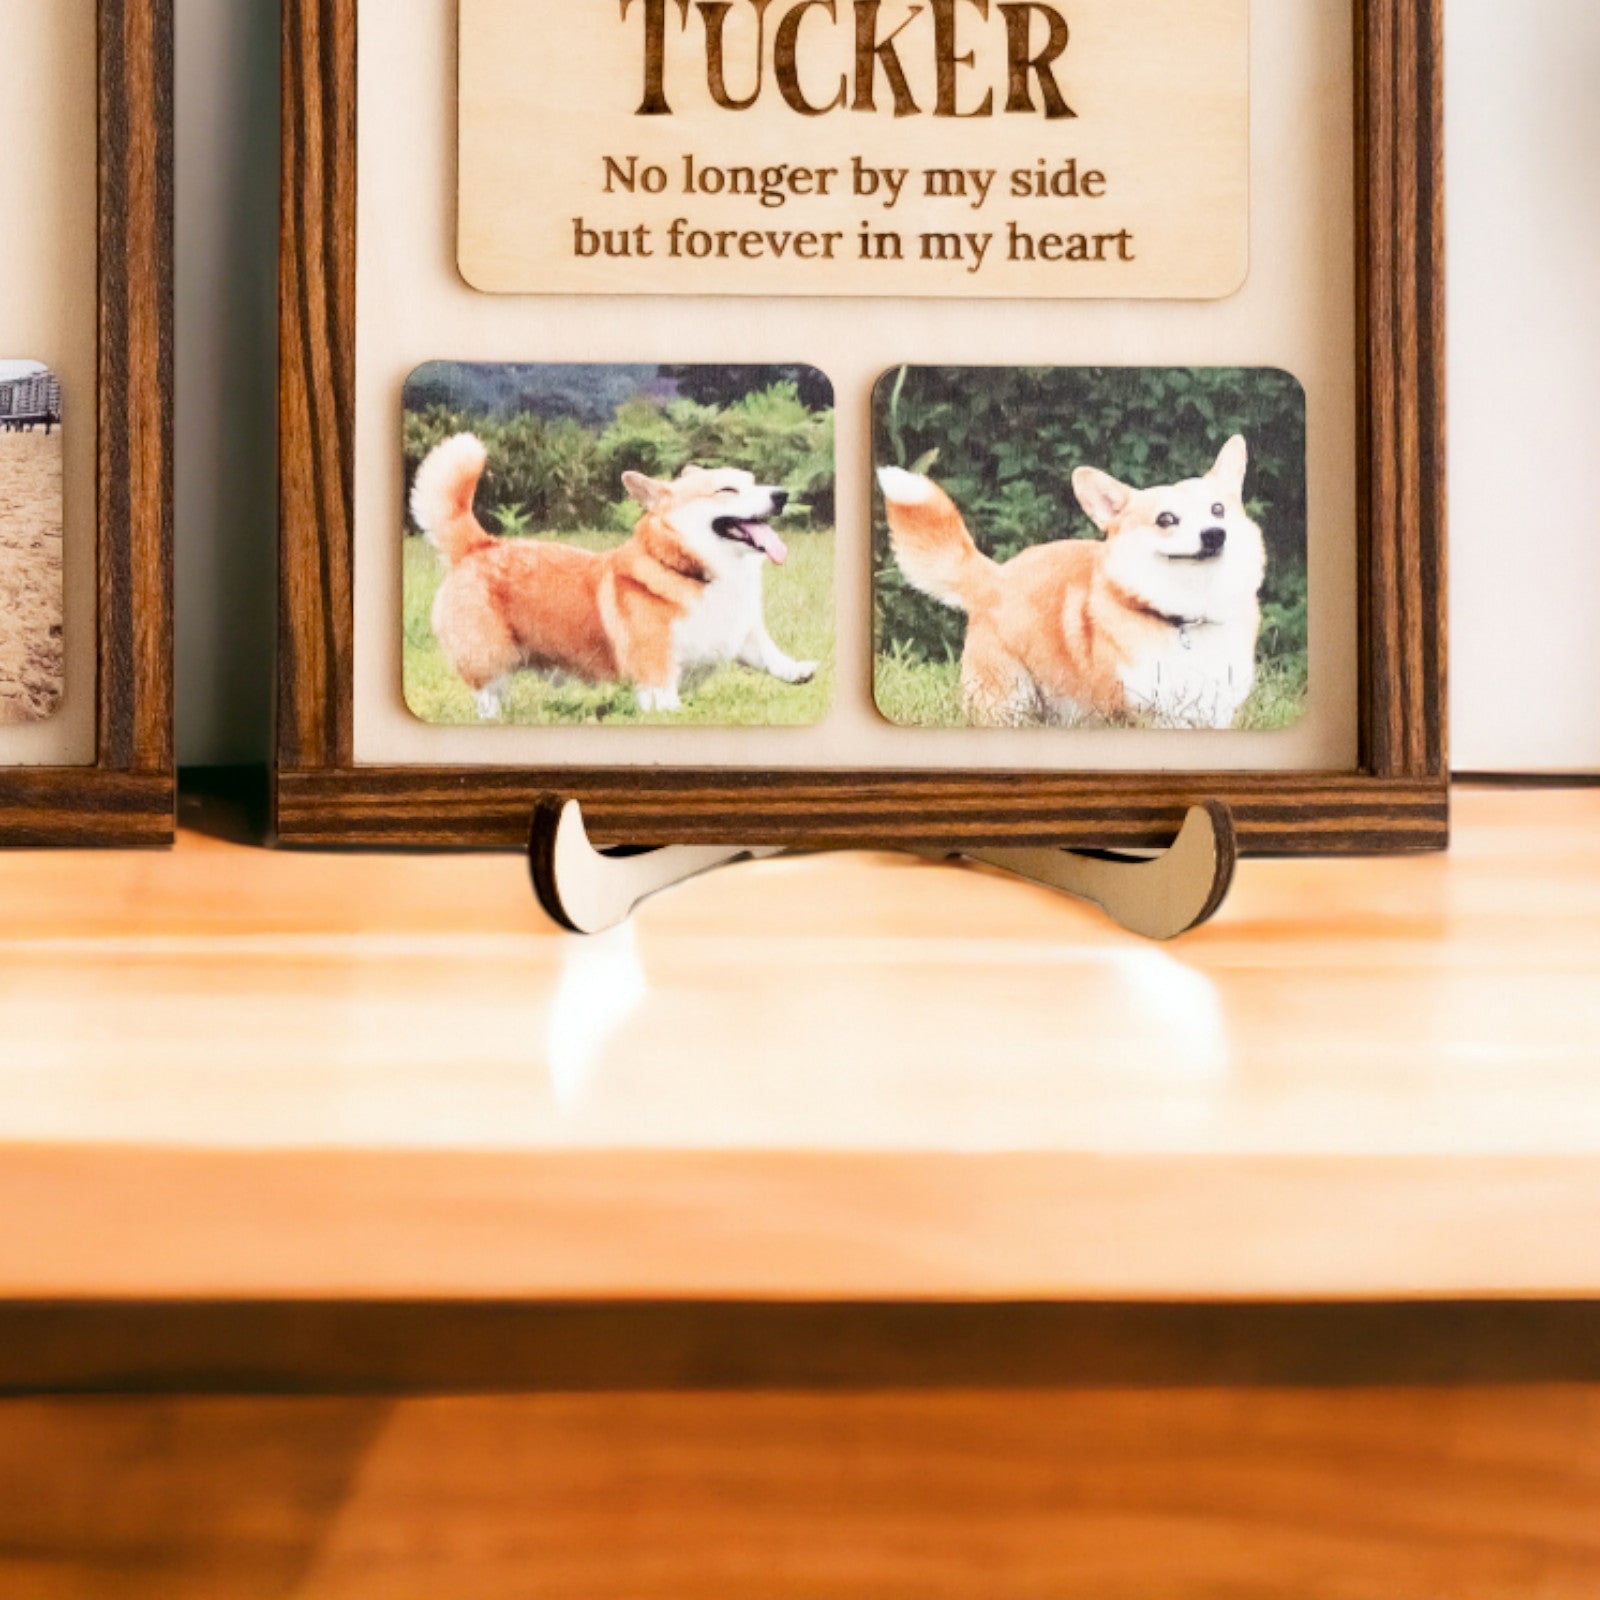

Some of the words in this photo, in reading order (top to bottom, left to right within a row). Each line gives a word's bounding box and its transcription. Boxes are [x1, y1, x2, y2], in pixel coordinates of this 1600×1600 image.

[602, 156, 667, 195] No
[682, 154, 838, 208] longer
[851, 156, 909, 208] by
[922, 169, 992, 209] my
[1009, 158, 1106, 197] side
[572, 217, 653, 257] but
[667, 218, 843, 259] forever
[858, 220, 903, 259] in
[919, 233, 993, 273] my
[1007, 221, 1135, 261] heart
